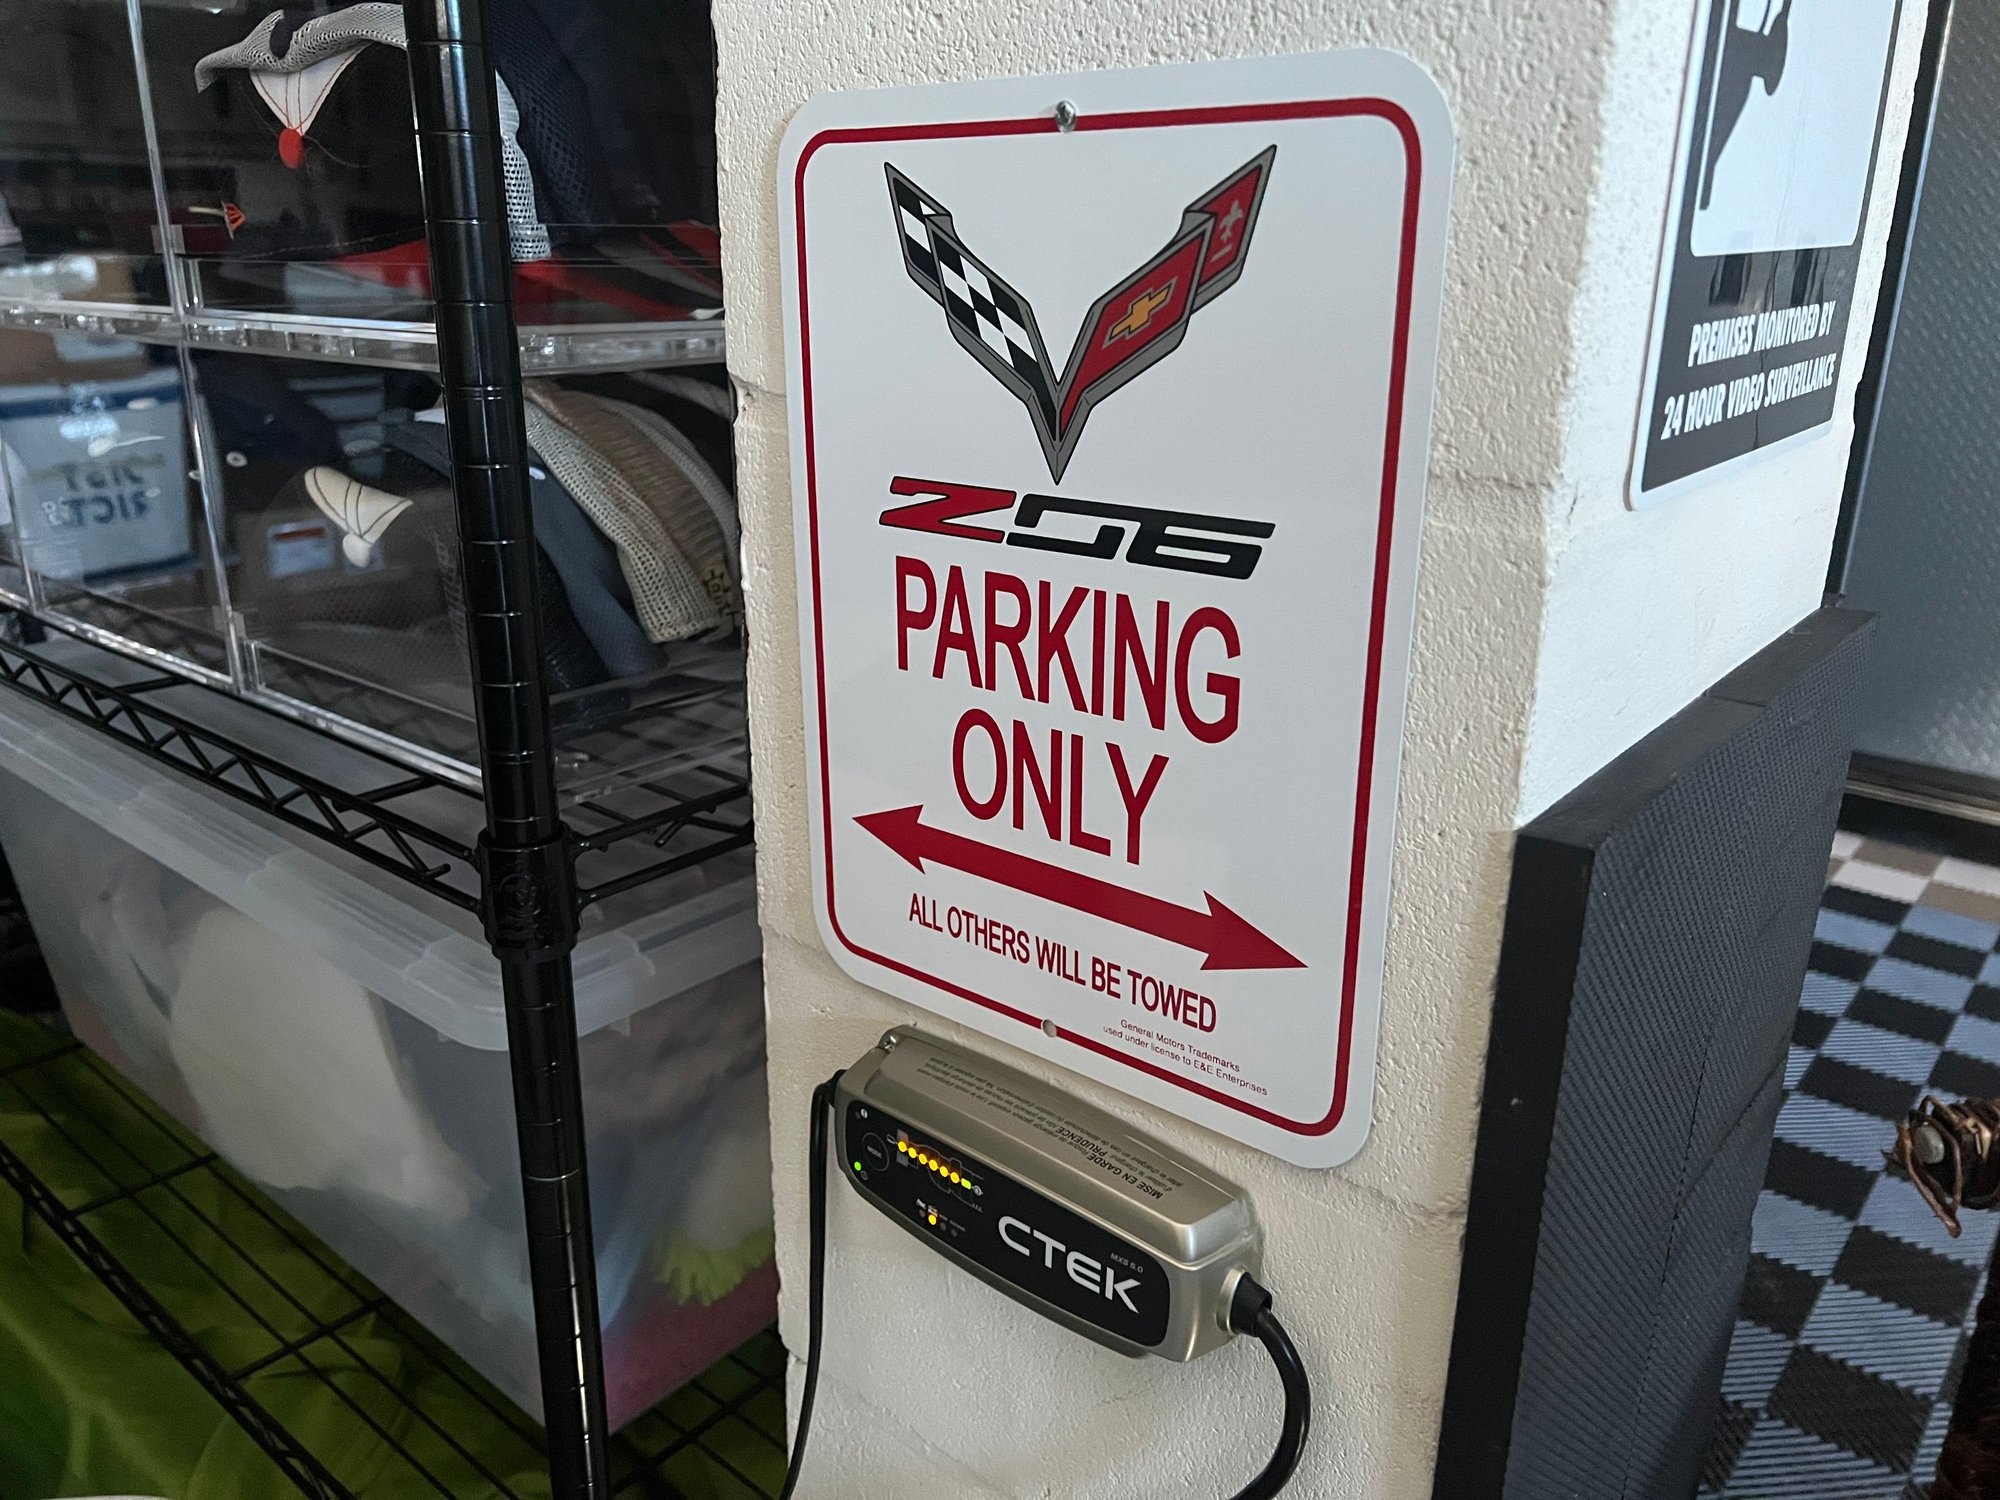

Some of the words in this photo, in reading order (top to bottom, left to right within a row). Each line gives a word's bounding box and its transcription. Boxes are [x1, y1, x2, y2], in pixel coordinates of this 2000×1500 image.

[1687, 314, 1756, 367] PREMISES
[1753, 303, 1820, 352] MONITORED
[1818, 300, 1837, 337] BY
[1660, 394, 1685, 440] 24
[1684, 383, 1727, 433] HOUR
[1727, 372, 1765, 419] VIDEO
[1765, 353, 1837, 407] SURVEILLANCE
[879, 475, 1276, 580] Z06
[895, 556, 1241, 744] PARKING
[952, 708, 1170, 865] ONLY
[909, 893, 943, 933] ALL
[947, 906, 1030, 964] OTHERS
[1035, 936, 1087, 986] WILL
[1092, 956, 1121, 999] BE
[1127, 969, 1217, 1033] TOWED
[1103, 1026, 1123, 1039] used
[1125, 1033, 1149, 1049] under
[1151, 1043, 1180, 1061] license
[1183, 1056, 1192, 1066] to
[1194, 1060, 1214, 1075] E&E
[1216, 1069, 1268, 1096] Enterprises
[1120, 1019, 1154, 1038] General
[1156, 1032, 1185, 1051] Motors
[1188, 1044, 1240, 1072] Trademarks
[1055, 1126, 1108, 1156] PRUDENCE
[1087, 1153, 1122, 1176] GARDE
[1121, 1173, 1138, 1184] EN
[1136, 1181, 1163, 1199] MISE
[998, 1215, 1141, 1314] CTEK
[1109, 1252, 1129, 1267] MXS
[1129, 1261, 1144, 1274] 5.0
